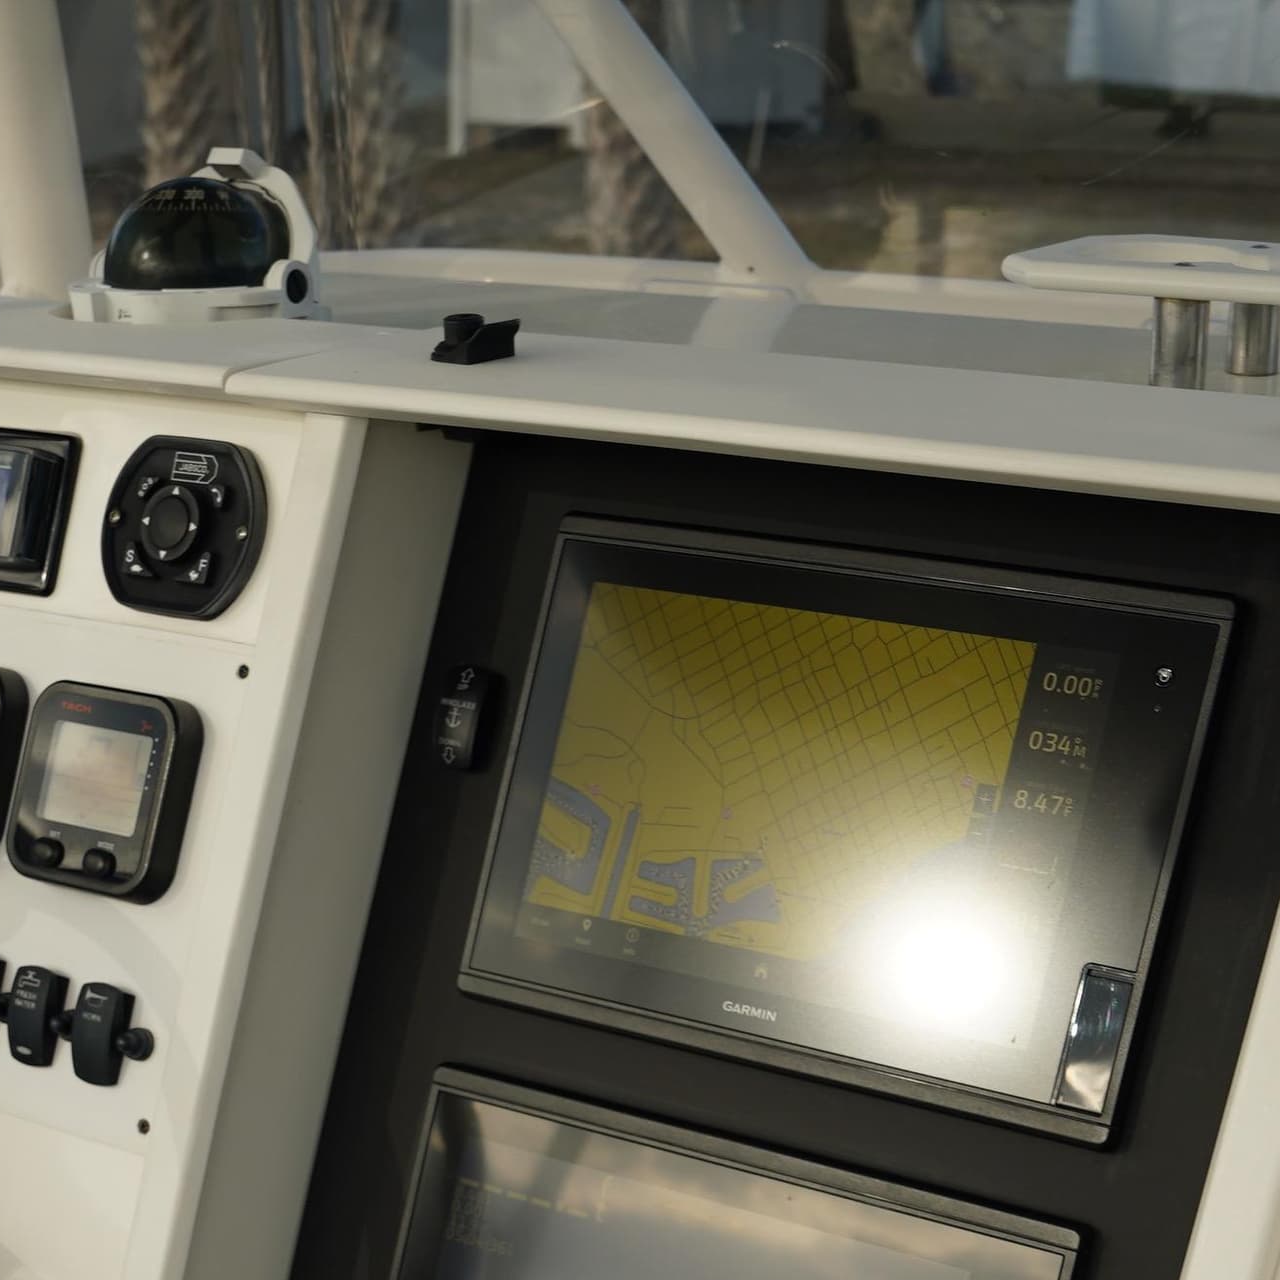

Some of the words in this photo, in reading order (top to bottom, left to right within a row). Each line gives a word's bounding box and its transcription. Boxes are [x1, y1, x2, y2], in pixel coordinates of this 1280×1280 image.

[125, 549, 135, 563] S
[198, 559, 209, 572] F
[1043, 671, 1093, 697] 0.00
[61, 701, 92, 714] TACH
[1028, 731, 1071, 755] 034
[1014, 790, 1064, 815] 8.47
[721, 1000, 777, 1022] GARMIN
